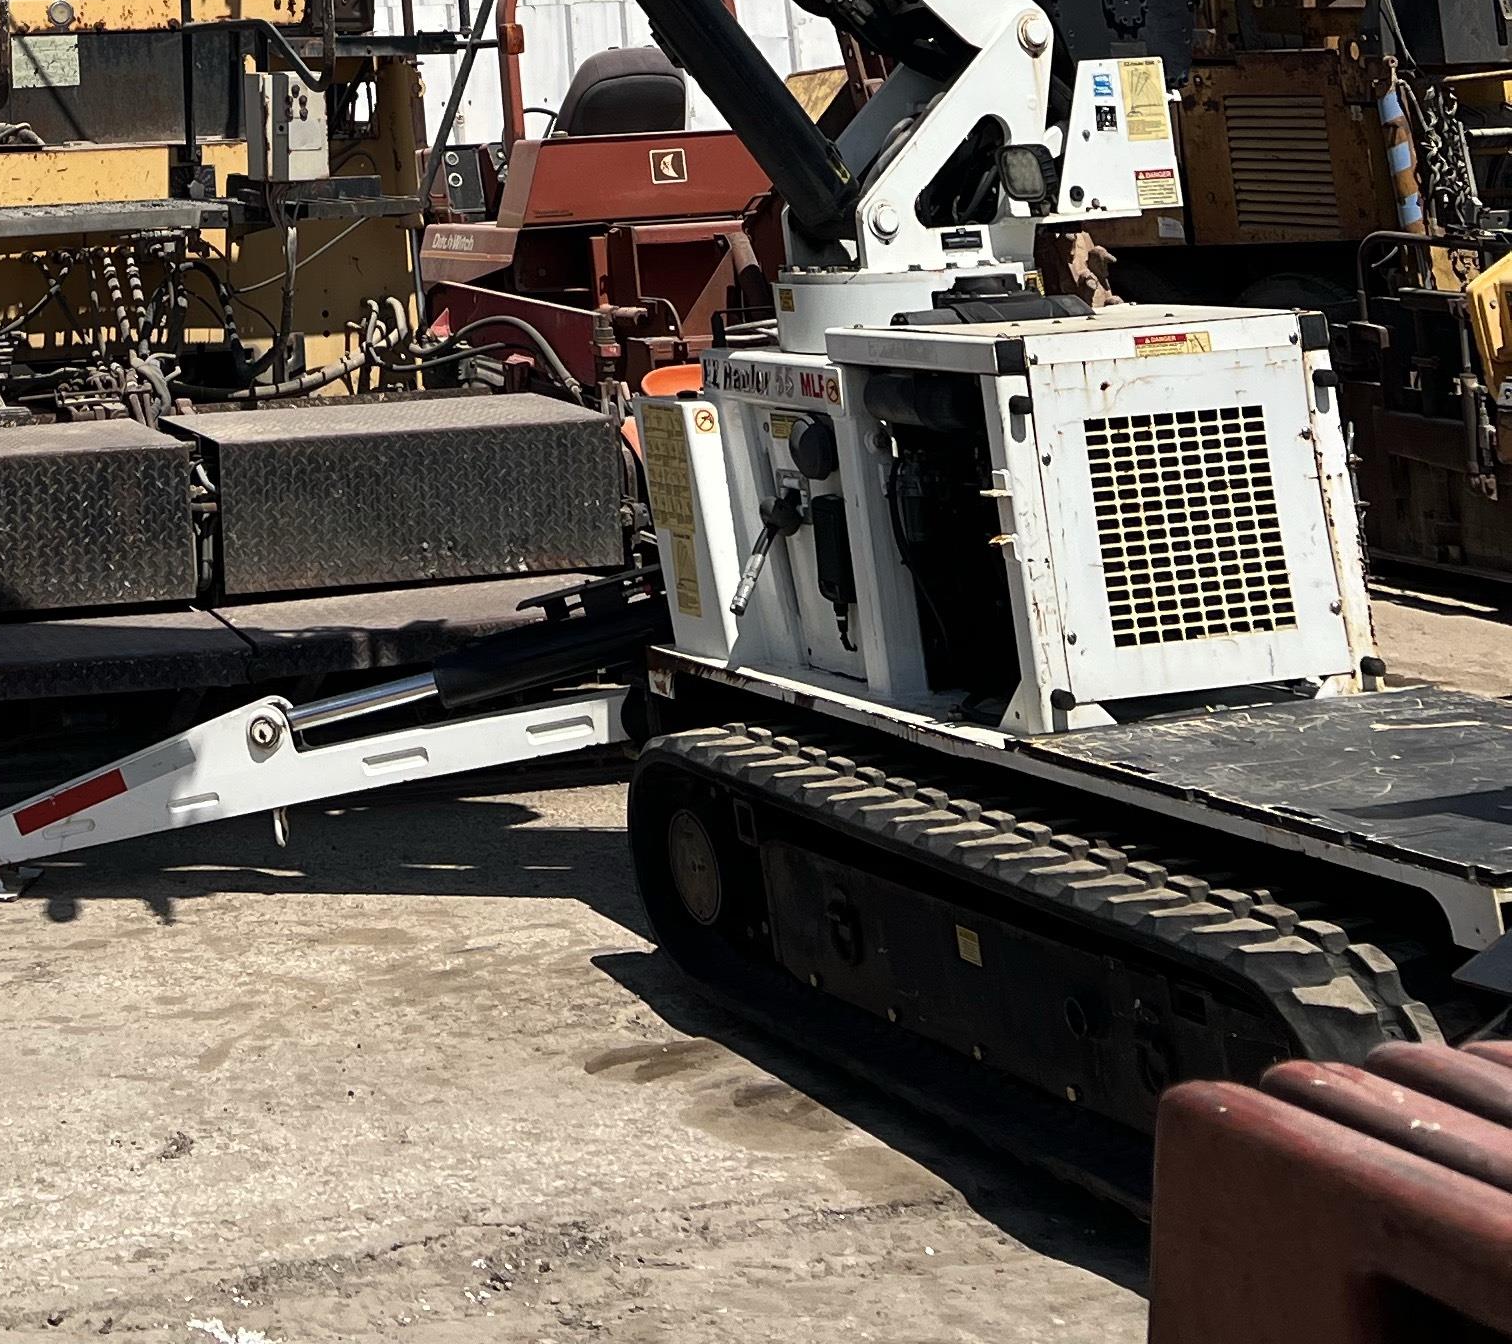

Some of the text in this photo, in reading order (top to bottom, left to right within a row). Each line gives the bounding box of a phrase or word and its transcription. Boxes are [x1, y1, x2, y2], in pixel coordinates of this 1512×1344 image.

[1145, 170, 1172, 179] DANGER
[1150, 335, 1177, 343] DANGER
[723, 360, 771, 396] Hauler
